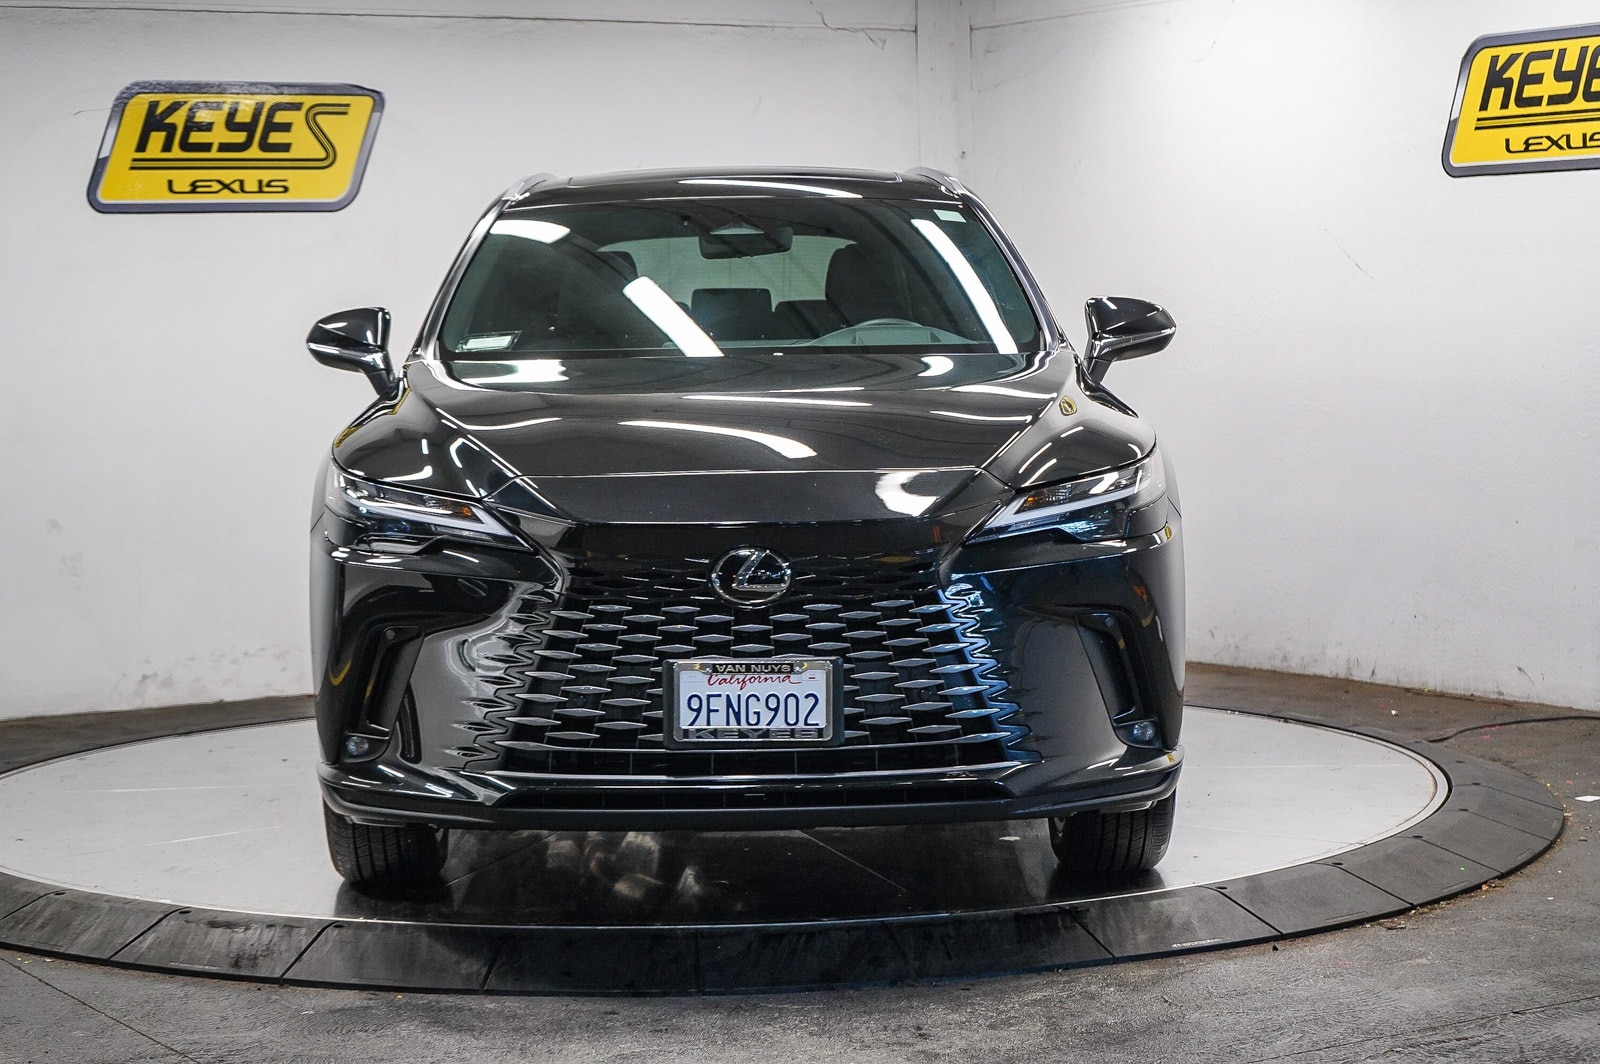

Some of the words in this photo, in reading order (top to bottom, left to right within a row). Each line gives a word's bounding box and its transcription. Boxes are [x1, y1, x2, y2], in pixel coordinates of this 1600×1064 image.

[133, 99, 350, 169] KEYES
[167, 179, 289, 194] LEXUS
[715, 664, 746, 673] VAN
[750, 664, 791, 673] NUYS
[707, 674, 801, 690] California
[686, 693, 820, 727] 9FNG902
